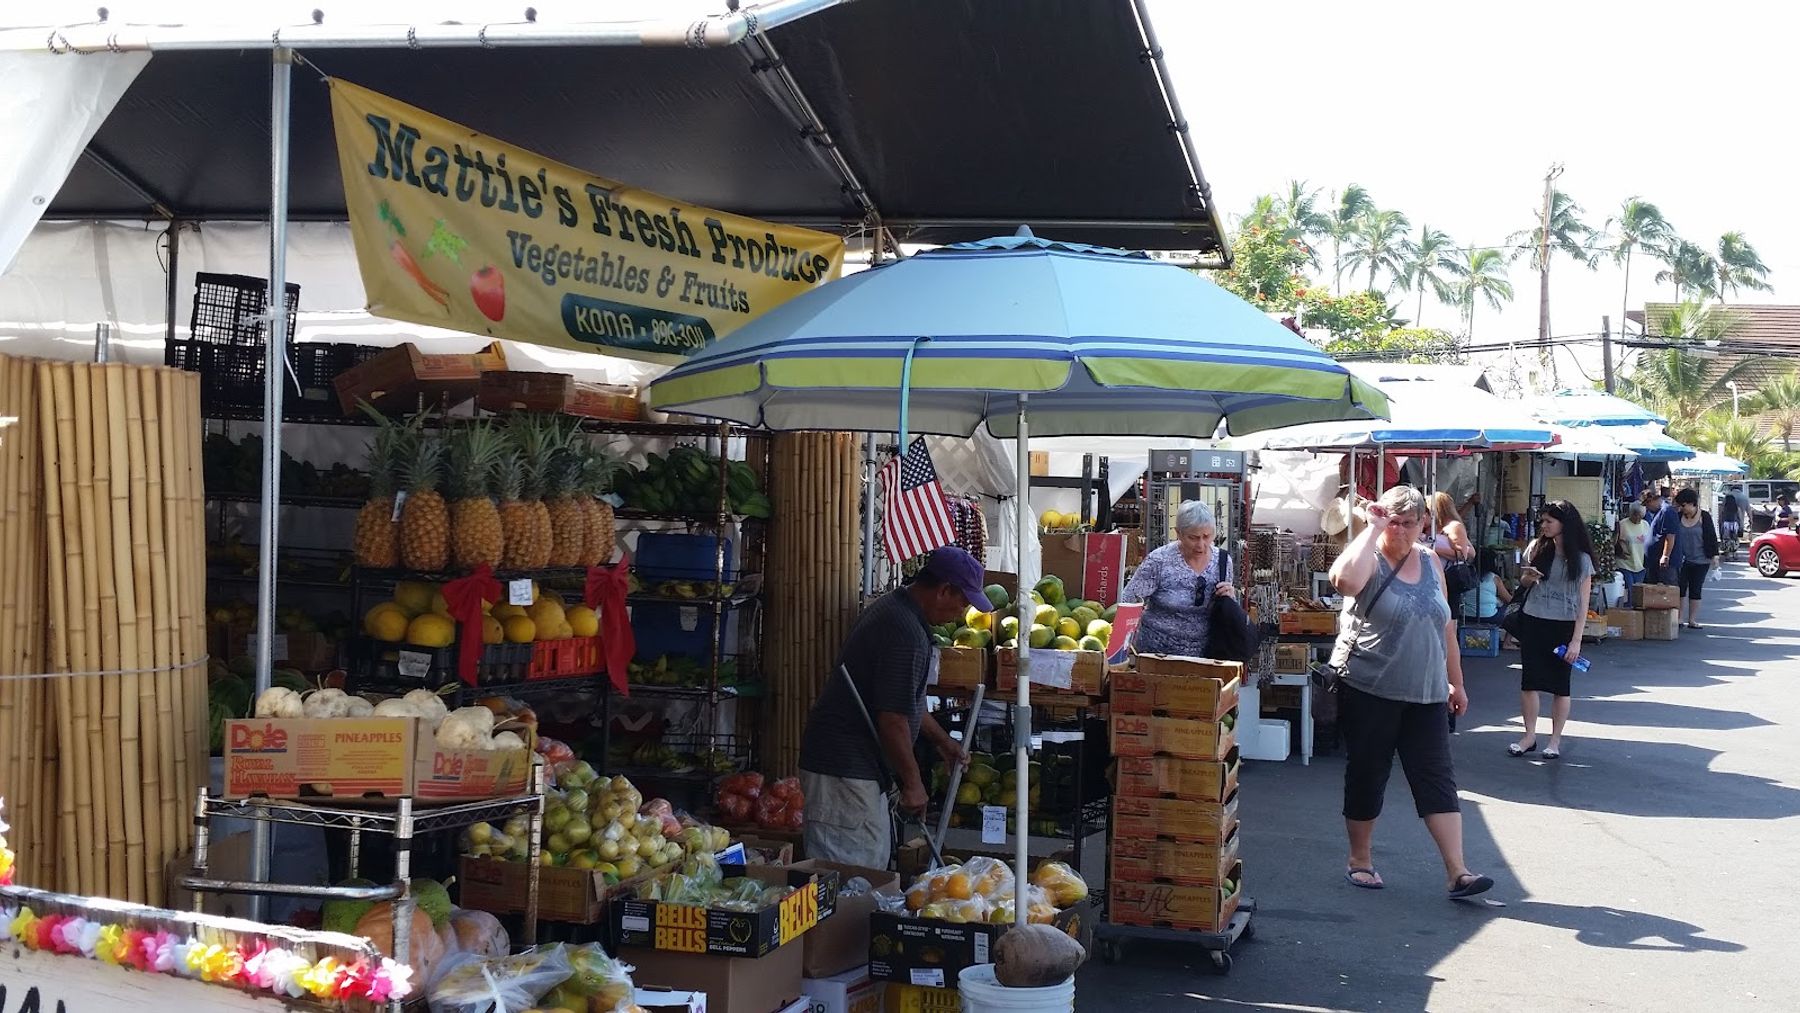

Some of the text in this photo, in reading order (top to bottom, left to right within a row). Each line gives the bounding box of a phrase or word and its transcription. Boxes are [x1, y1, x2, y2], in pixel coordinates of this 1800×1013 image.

[366, 113, 830, 283] Mattie's Fresh Produce
[507, 229, 750, 313] Vegetables & Fruits
[575, 305, 636, 340] KONA
[231, 723, 403, 749] Dole PINEAPPLES
[1116, 718, 1149, 731] Dole
[655, 903, 707, 930] BELLS
[780, 882, 818, 947] BELLS
[655, 926, 707, 953] BELLS
